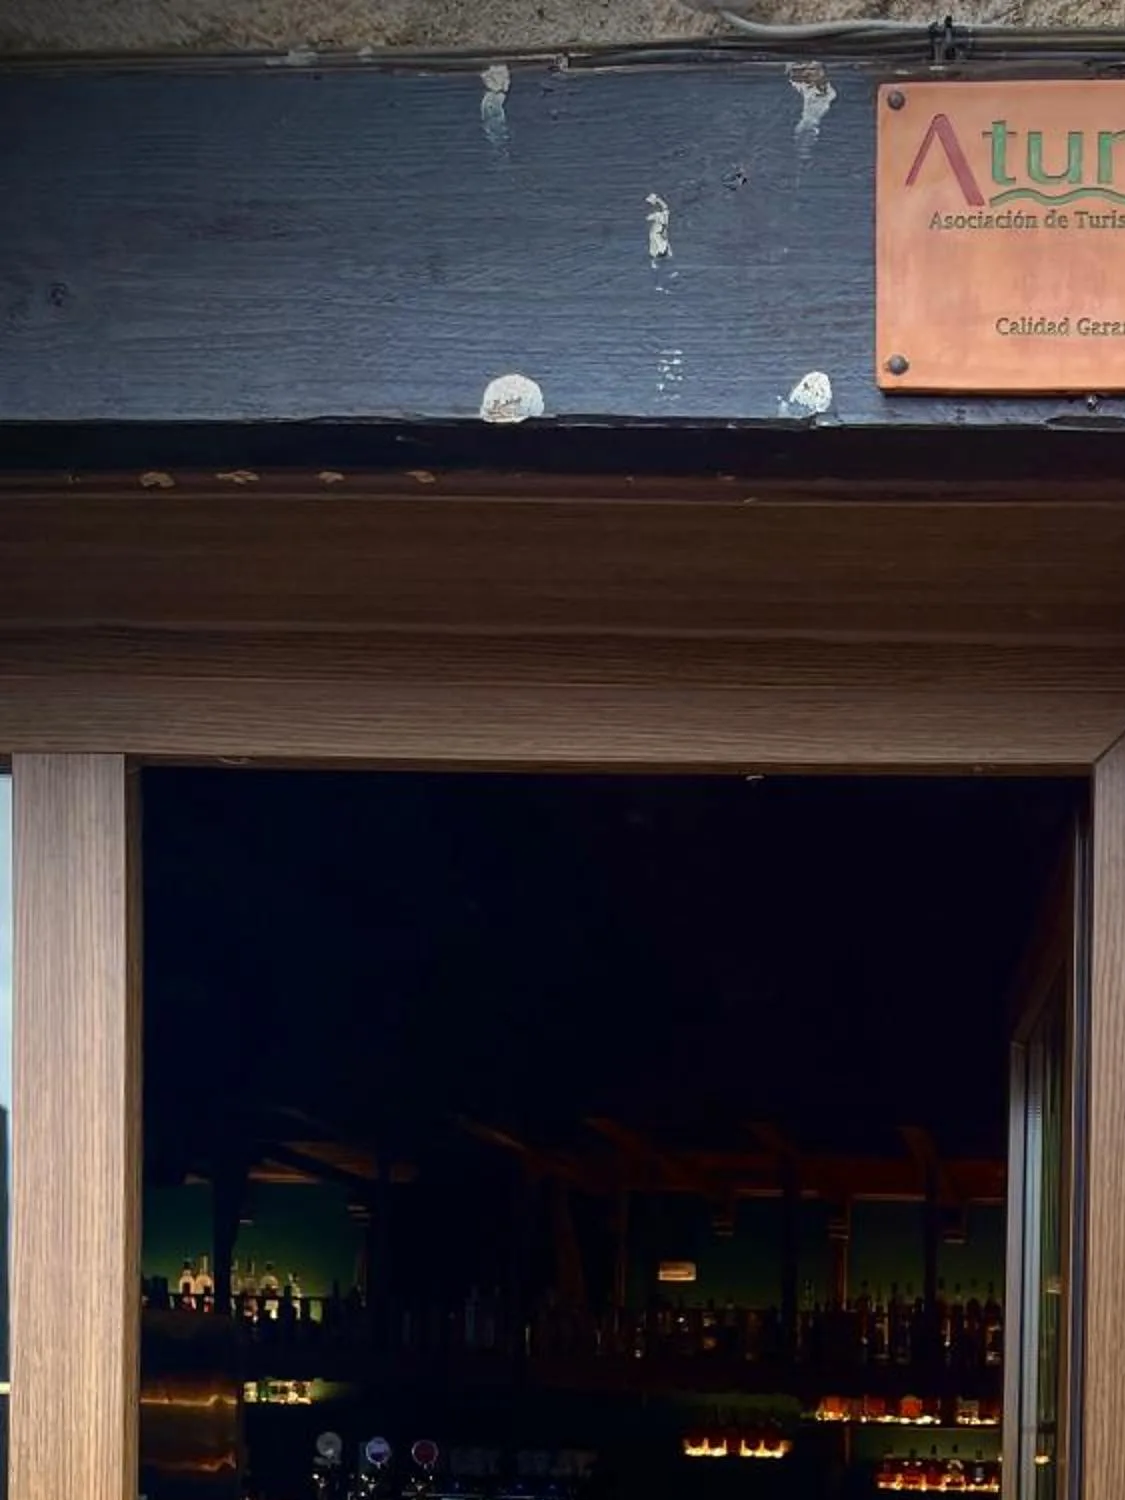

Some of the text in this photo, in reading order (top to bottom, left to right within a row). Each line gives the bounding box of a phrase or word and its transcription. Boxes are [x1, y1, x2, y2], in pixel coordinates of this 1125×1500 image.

[929, 211, 1038, 230] Asociación
[1044, 211, 1068, 230] de
[995, 315, 1069, 337] Calidad
